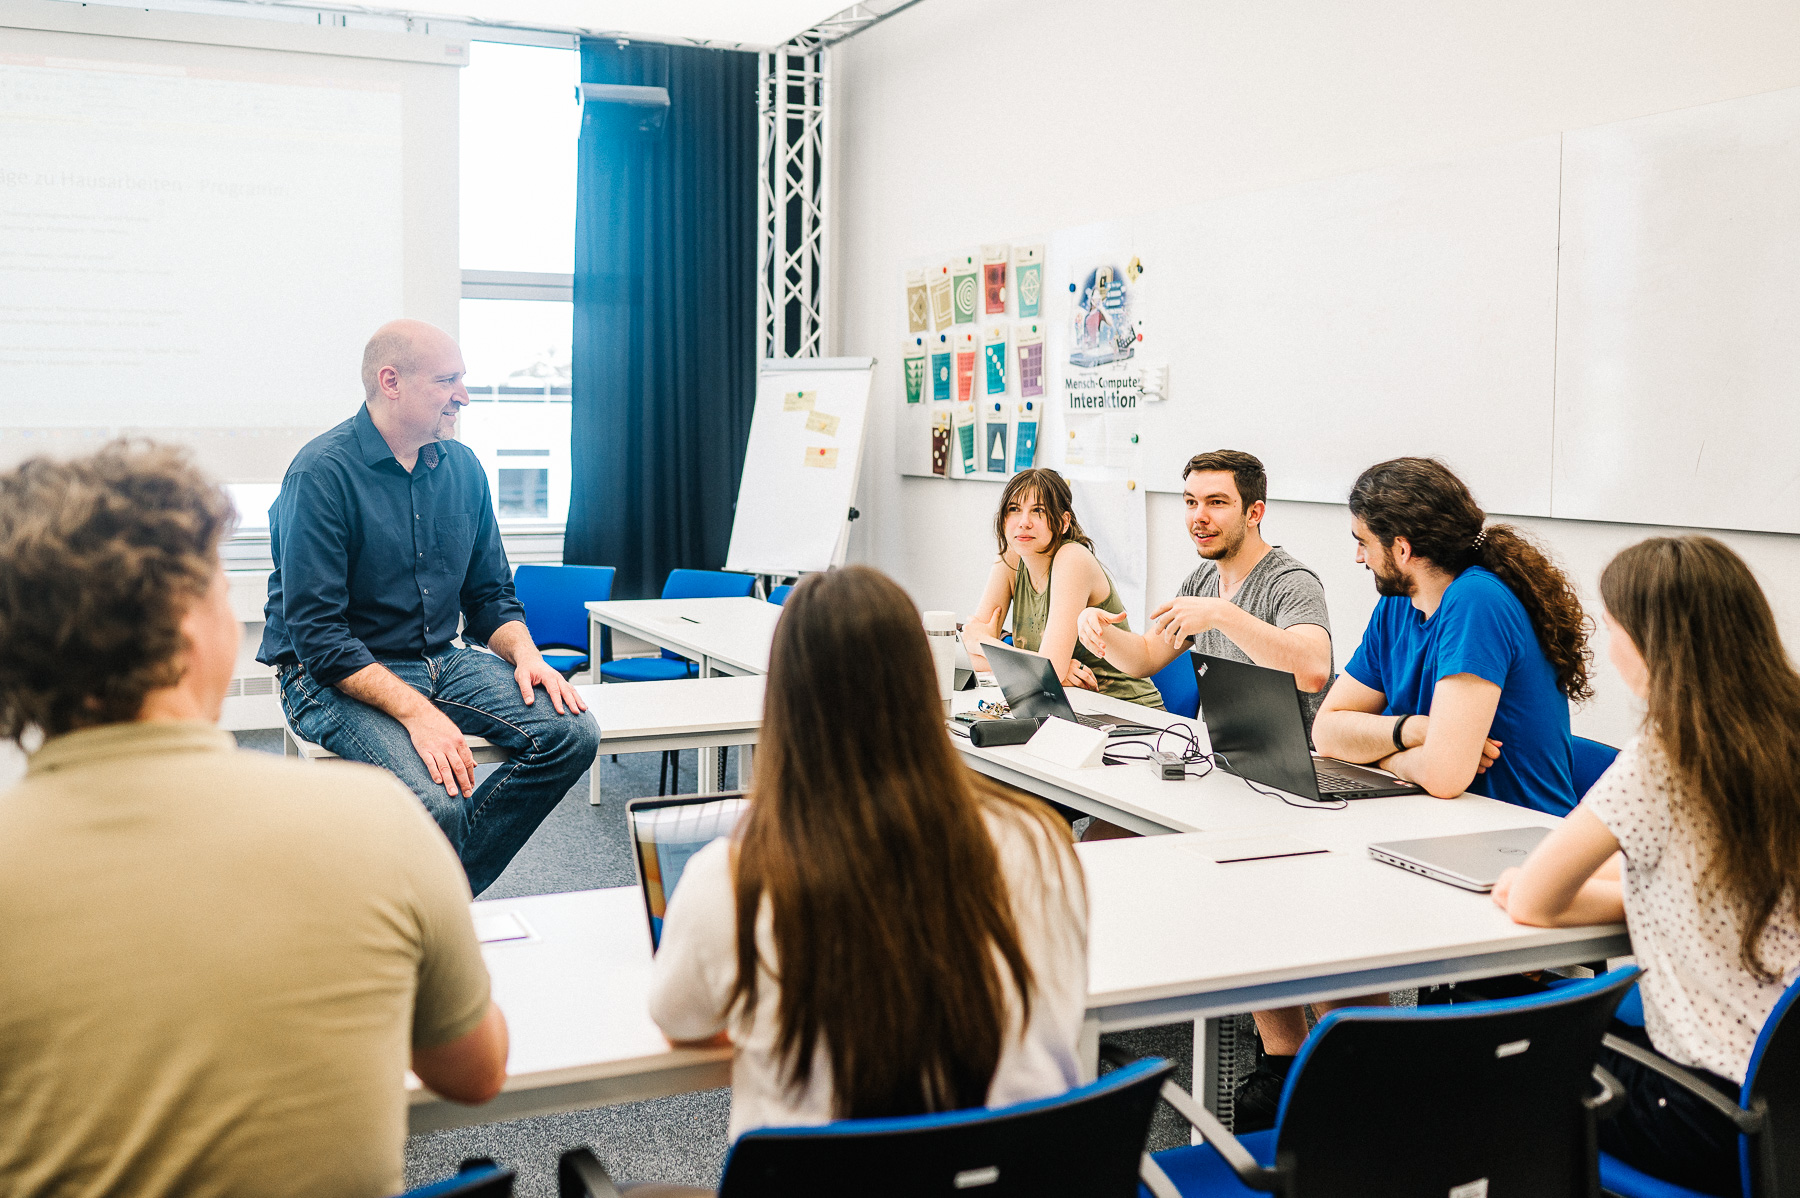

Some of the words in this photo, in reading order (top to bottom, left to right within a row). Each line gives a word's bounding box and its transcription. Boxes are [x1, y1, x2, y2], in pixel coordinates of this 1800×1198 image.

[34, 173, 55, 187] zu
[61, 171, 183, 192] Hausarbeiten
[1070, 390, 1136, 408] Interaktion
